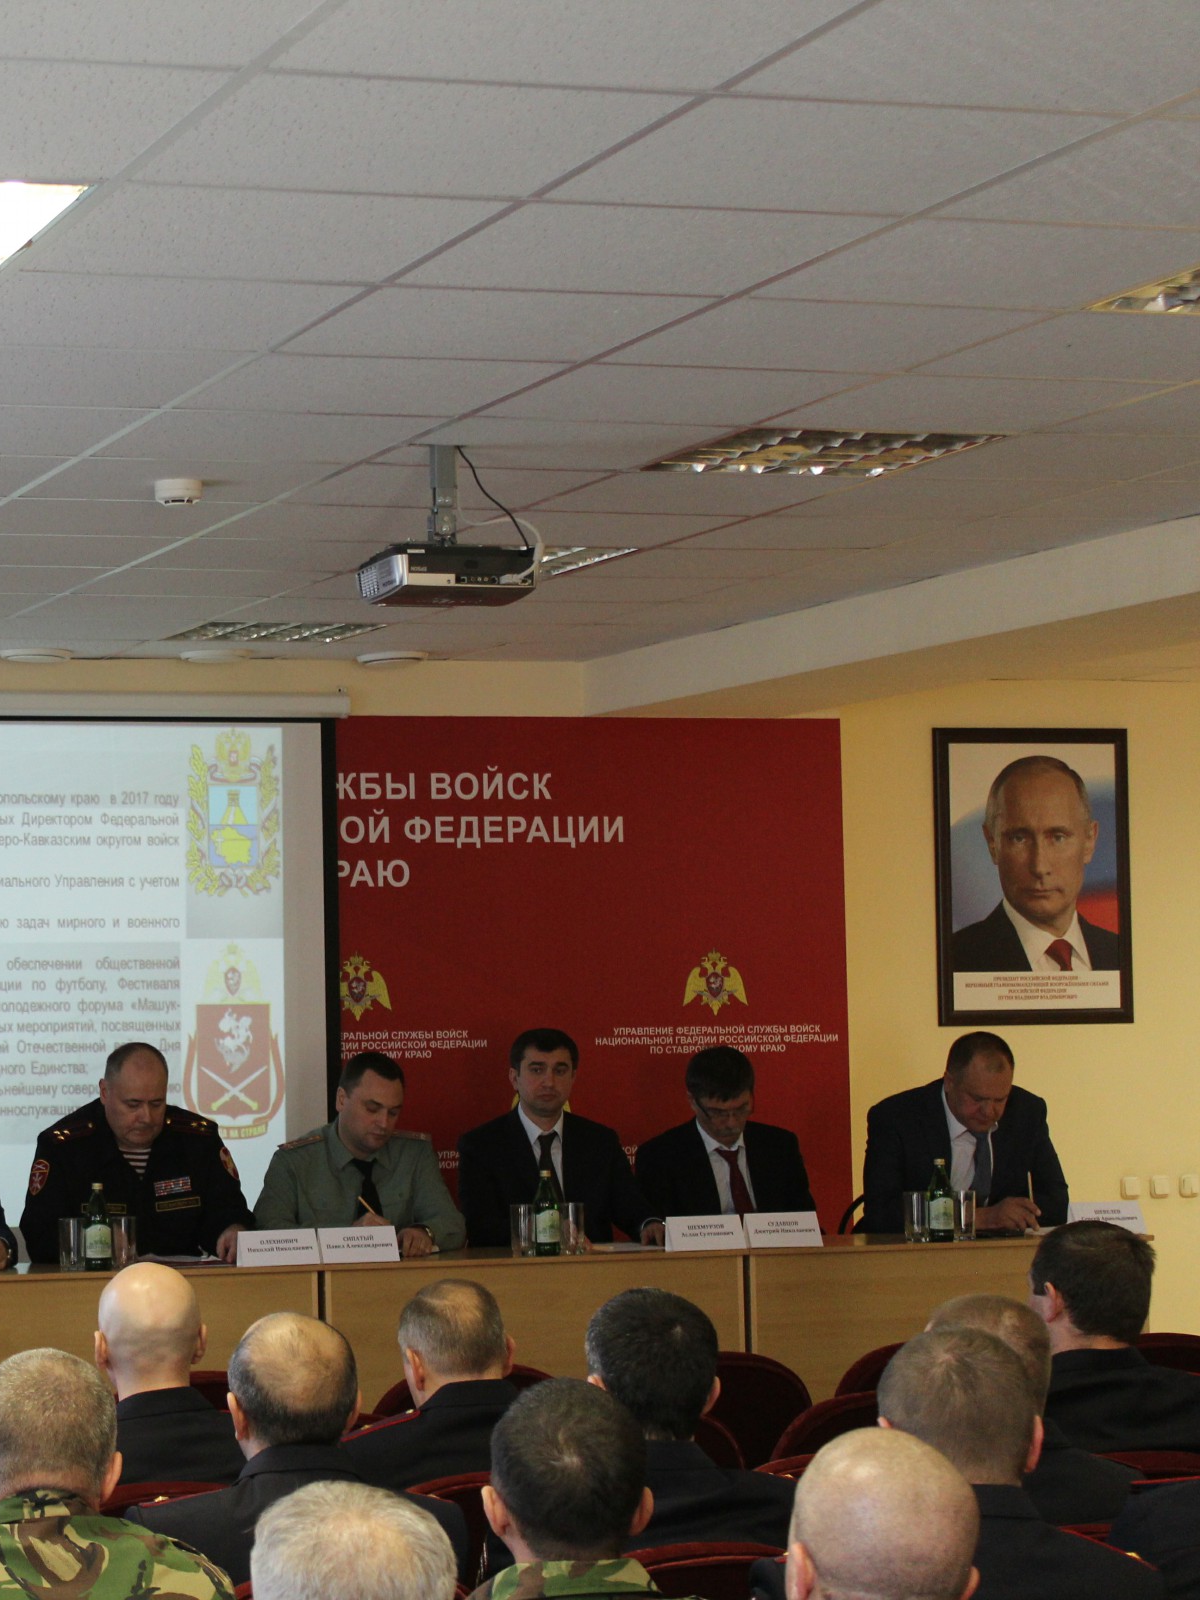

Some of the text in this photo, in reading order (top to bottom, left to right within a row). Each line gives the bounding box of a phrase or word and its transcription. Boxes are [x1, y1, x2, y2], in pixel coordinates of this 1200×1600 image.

[430, 765, 552, 800] ВОЙСК
[71, 793, 100, 807] краю
[121, 791, 148, 805] 2017
[154, 794, 179, 808] году
[21, 811, 92, 829] Директором
[100, 812, 179, 828] Федеральной
[404, 815, 625, 849] ФЕДЕРАЦИИ
[96, 835, 141, 849] округом
[147, 833, 179, 846] войск
[55, 874, 124, 890] Управления
[140, 876, 179, 890] учетом
[17, 917, 49, 929] задач
[57, 917, 105, 930] мирного
[128, 917, 180, 928] военного
[7, 956, 82, 970] обеспечении
[96, 955, 180, 971] общественной
[32, 979, 46, 991] по
[118, 976, 180, 990] Фестиваля
[77, 998, 123, 1015] форума
[101, 1019, 181, 1033] посвященных
[613, 1023, 821, 1036] УПРАВЛЕНИЕ ФЕДЕРАЛЬНОЙ СЛУЖБЫ ВОЙСК
[391, 1030, 434, 1040] СЛУЖБЫ
[436, 1029, 468, 1039] ВОЙСК
[595, 1033, 839, 1046] НАЦИОНАЛЬНОЙ ГВАРДИИ РОССИЙСКОЙ ФЕДЕРАЦИИ
[17, 1037, 105, 1054] Отечественной
[361, 1039, 488, 1050] РОССИЙСКОЙ ФЕДЕРАЦИИ
[650, 1043, 786, 1054] ПО КРАЮ
[405, 1049, 432, 1059] КРАЮ
